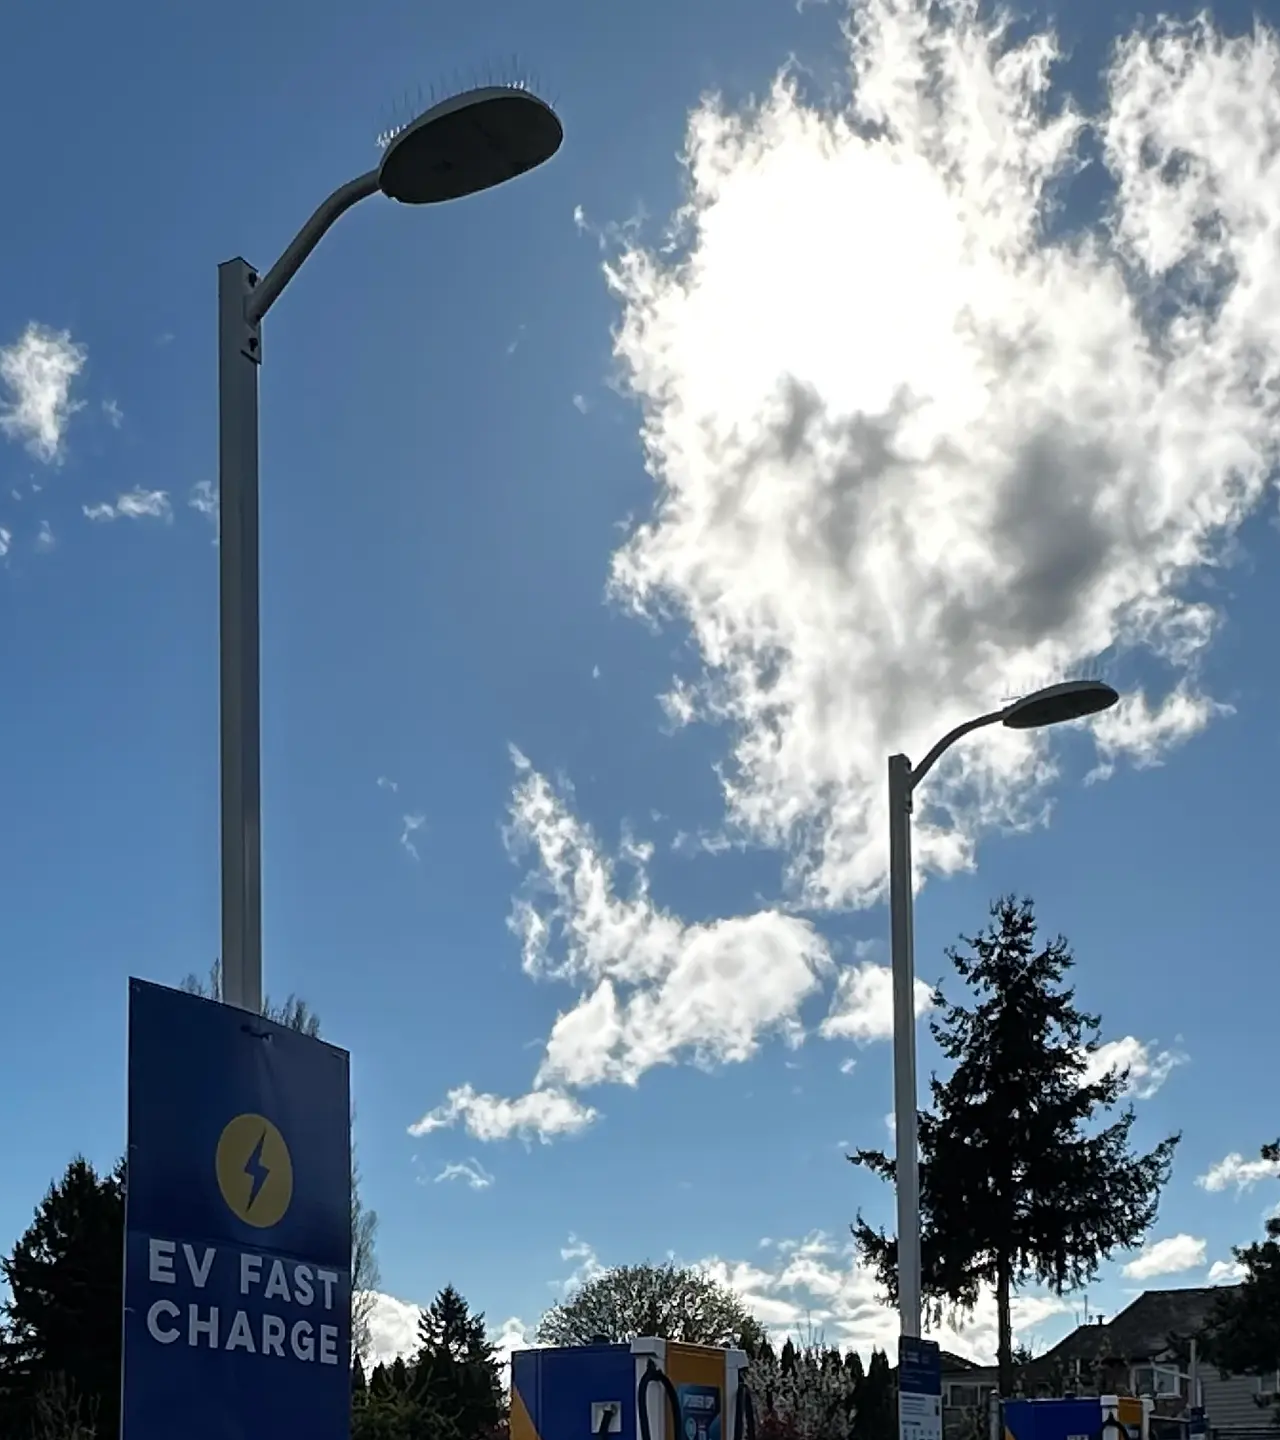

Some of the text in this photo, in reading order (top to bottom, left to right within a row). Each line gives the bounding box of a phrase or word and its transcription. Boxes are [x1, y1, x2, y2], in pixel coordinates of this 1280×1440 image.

[148, 1237, 339, 1310] EV FAST
[147, 1299, 339, 1365] CHARGE
